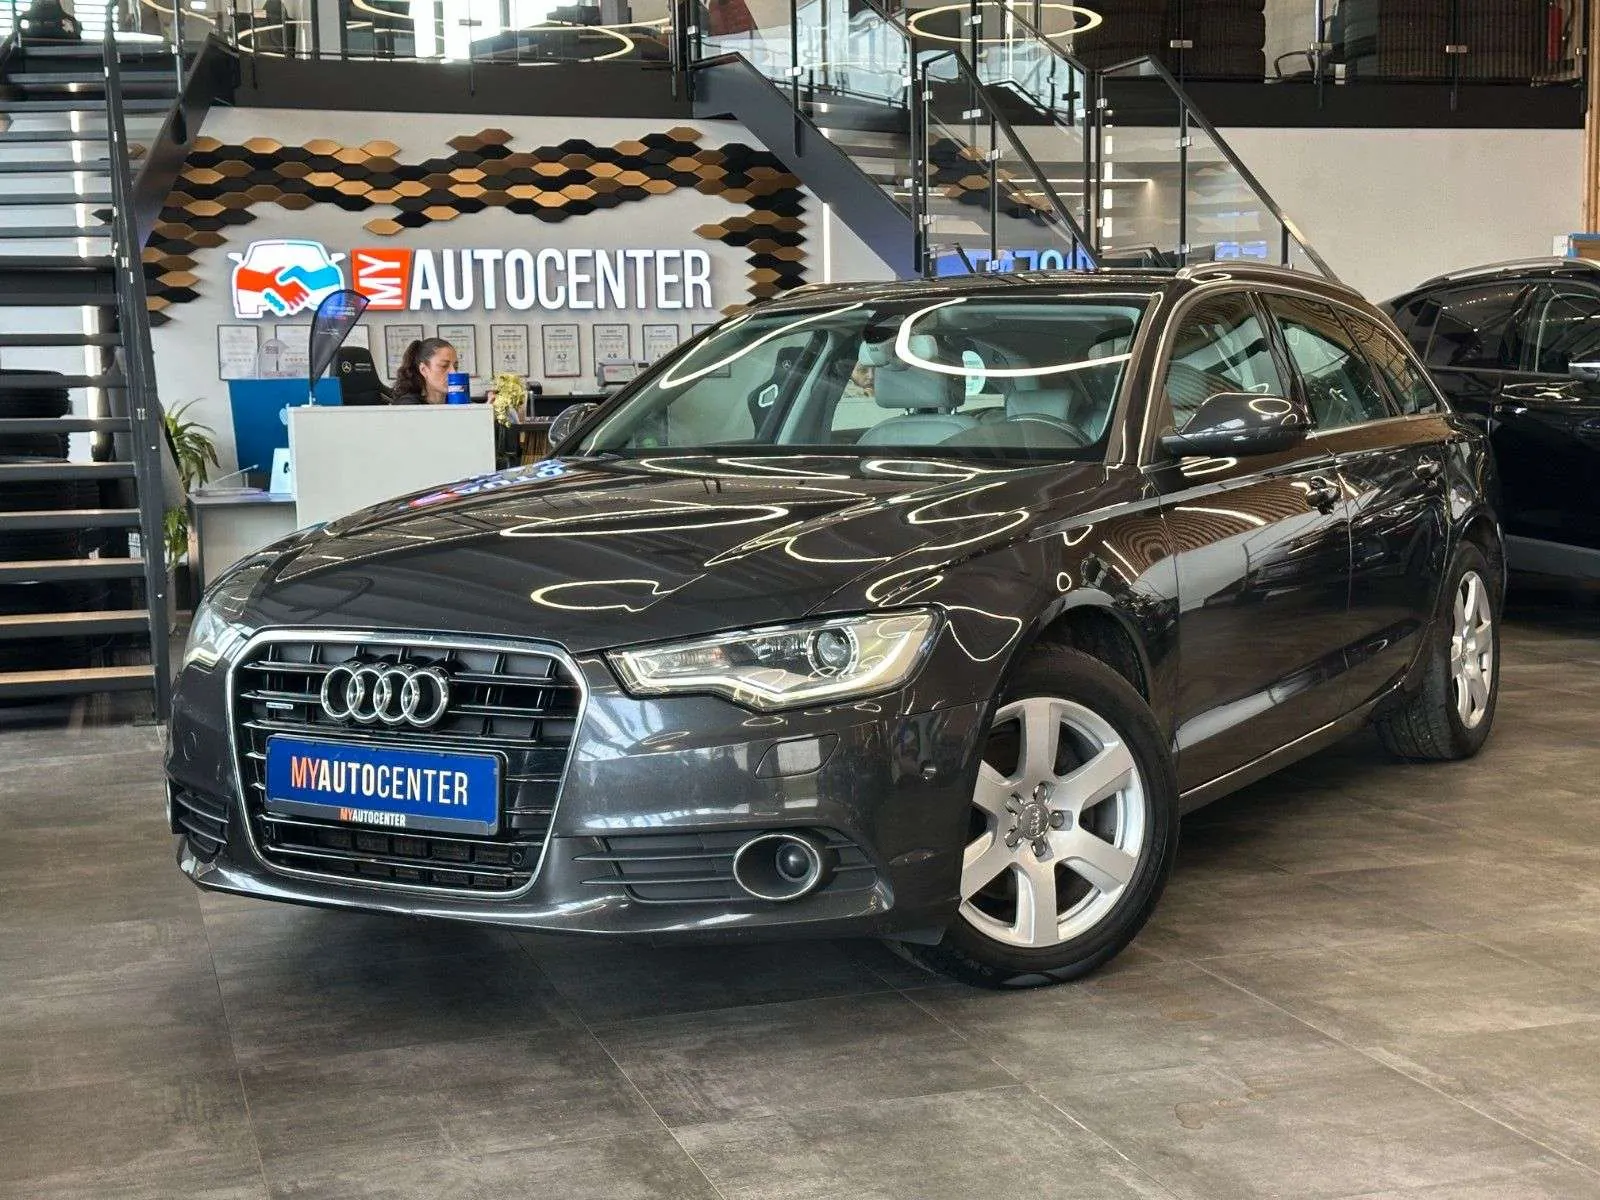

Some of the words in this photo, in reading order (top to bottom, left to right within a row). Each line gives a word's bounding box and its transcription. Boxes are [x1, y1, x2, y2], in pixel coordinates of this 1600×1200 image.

[358, 253, 402, 305] MY
[409, 248, 713, 311] AUTOCENTER
[290, 755, 469, 806] MYAUTOCENTER
[339, 807, 406, 828] MYAUTOCENTER
